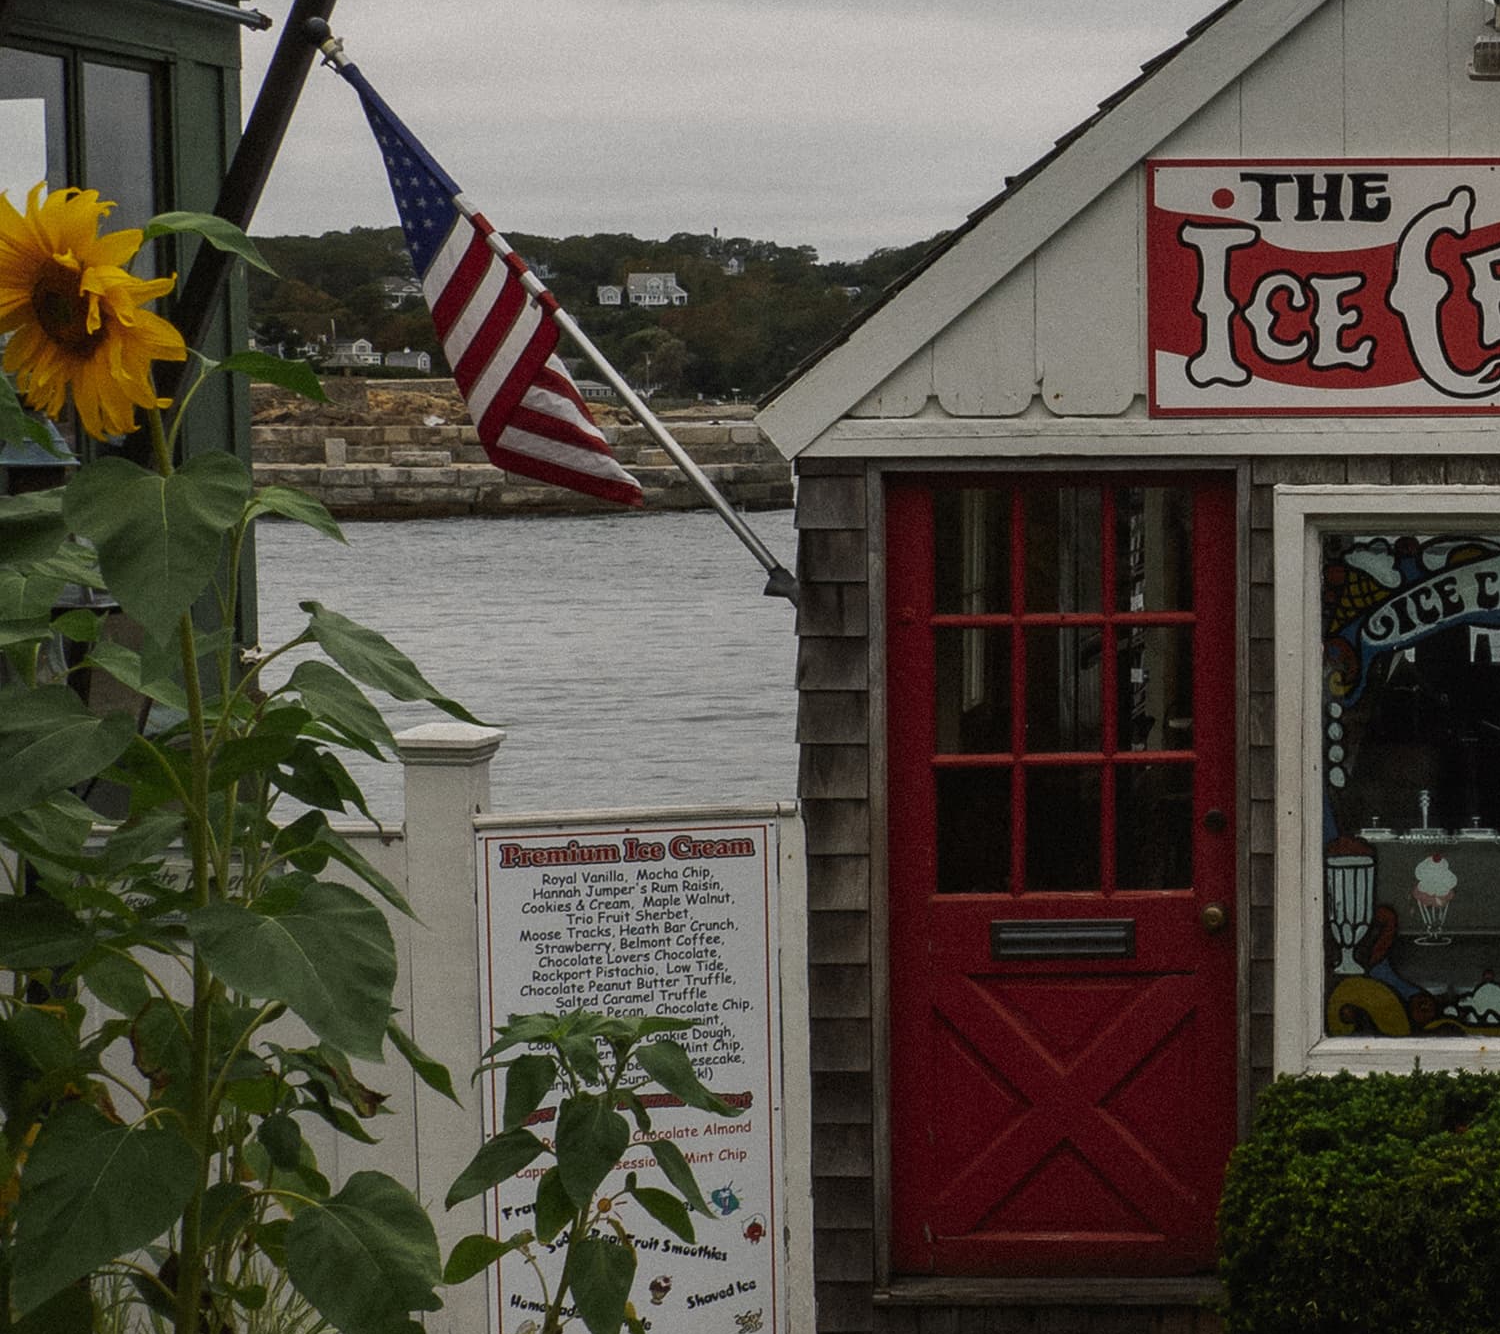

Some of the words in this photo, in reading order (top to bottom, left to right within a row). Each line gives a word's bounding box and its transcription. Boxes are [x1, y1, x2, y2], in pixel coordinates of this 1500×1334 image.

[1240, 172, 1391, 222] THE
[1391, 576, 1465, 635] ICE
[499, 840, 621, 868] Premium
[623, 838, 665, 862] Ice
[669, 835, 756, 860] Cream
[542, 872, 577, 887] Royal
[582, 870, 628, 884] Vanilla,
[636, 868, 678, 880] Mocha
[682, 866, 714, 881] Chip,
[533, 886, 581, 899] Hannah
[586, 882, 647, 899] Jumper's
[651, 882, 678, 893] Rum
[682, 879, 724, 892] Raisin,
[521, 901, 571, 914] Cookies
[576, 899, 585, 911] &
[589, 898, 634, 911] Cream,
[642, 895, 681, 909] Maple
[685, 892, 735, 906] Walnut,
[566, 914, 593, 926] Trio
[597, 911, 630, 924] Fruit
[635, 908, 693, 922] Sherbet,
[519, 930, 562, 942] Moose
[566, 926, 616, 938] Tracks,
[619, 923, 659, 936] Heath
[664, 921, 687, 934] Bar
[689, 918, 738, 932] Crunch,
[534, 941, 616, 955] Strawberry,
[620, 937, 671, 950] Belmont
[675, 933, 725, 946] Coffee,
[538, 954, 603, 968] Chocolate
[607, 952, 650, 965] Lovers
[654, 947, 721, 961] Chocolate,
[532, 969, 592, 984] Rockport
[596, 964, 658, 978] Pistachio,
[666, 963, 691, 974] Low
[695, 960, 728, 972] Tide,
[520, 982, 585, 996] Chocolate
[589, 980, 632, 992] Peanut
[636, 977, 680, 990] Butter
[684, 972, 737, 986] Truffle,
[555, 995, 598, 1008] Salted
[602, 990, 654, 1005] Caramel
[659, 987, 707, 1001] Truffle
[655, 1001, 719, 1015] Chocolate
[722, 998, 754, 1013] Chip,
[692, 1026, 735, 1041] Dough,
[713, 1039, 745, 1052] Chip,
[632, 1127, 698, 1142] Chocolate
[704, 1120, 752, 1136] Almond
[718, 1147, 748, 1163] Chip
[661, 1239, 728, 1261] Smoothies
[686, 1283, 735, 1309] Shaved
[736, 1279, 756, 1294] Ice
